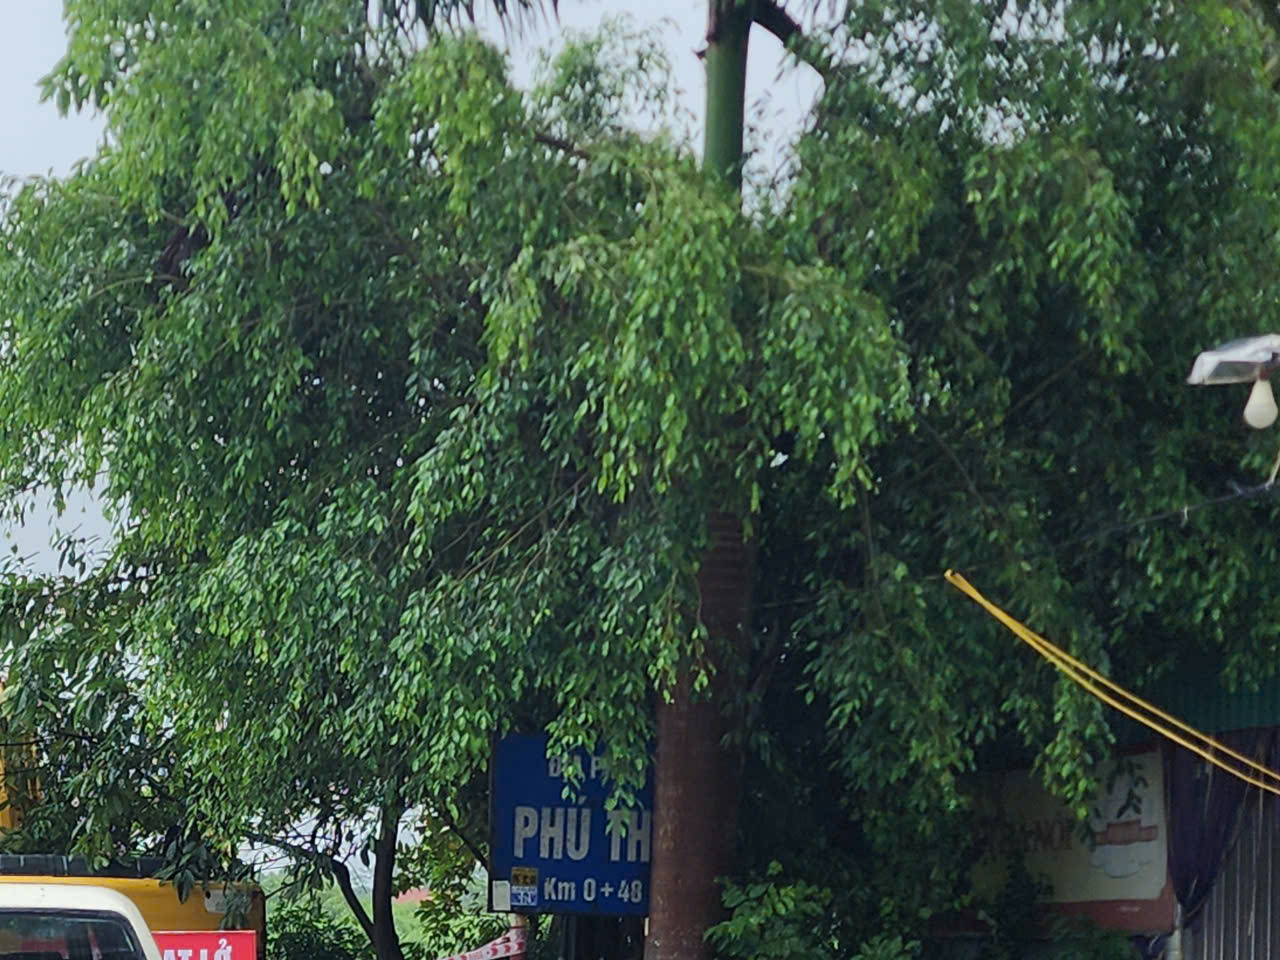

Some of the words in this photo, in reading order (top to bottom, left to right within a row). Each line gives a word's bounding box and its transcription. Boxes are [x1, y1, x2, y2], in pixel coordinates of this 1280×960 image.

[514, 796, 591, 860] PHÚ
[606, 808, 652, 862] TH
[543, 877, 576, 901] Km
